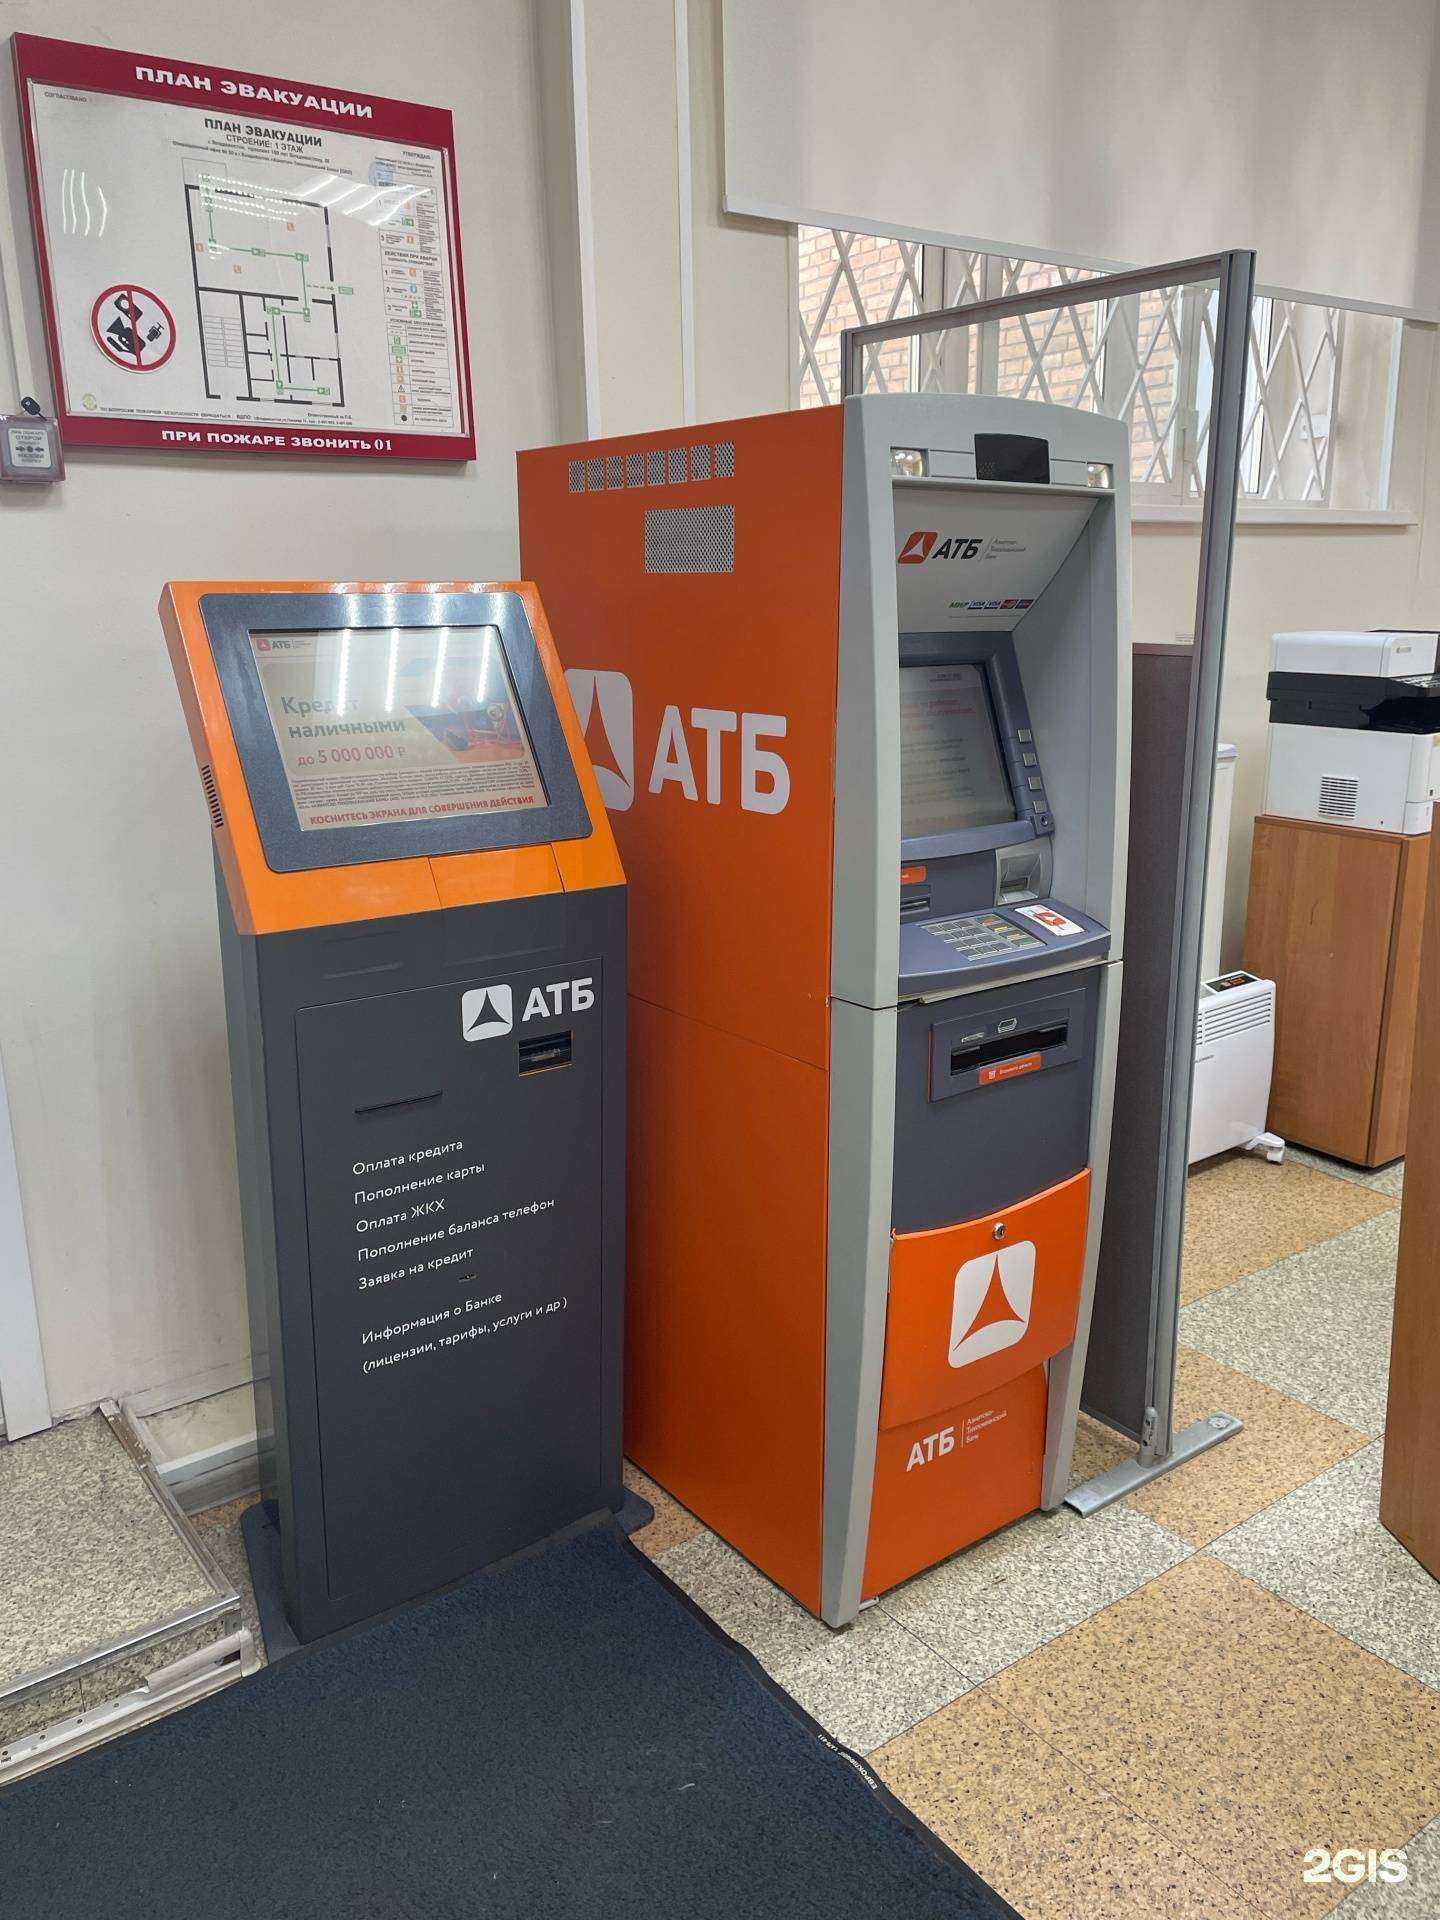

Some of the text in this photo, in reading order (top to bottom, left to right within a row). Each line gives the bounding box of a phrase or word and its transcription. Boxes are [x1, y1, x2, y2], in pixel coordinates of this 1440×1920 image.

[135, 66, 373, 119] ПЛАН ЭВАКУАЦИИ
[204, 118, 241, 134] ПЛАН
[245, 125, 322, 147] ЭВАКУАЦИИ
[275, 140, 279, 149] 1
[281, 144, 303, 154] ЭТАЖ
[161, 430, 392, 451] ПРИ ПОЖАРЕ ЗВОНИТЬ 01
[931, 538, 983, 560] АТБ
[287, 720, 406, 739] наличными
[297, 756, 315, 767] до
[318, 749, 328, 763] 5
[331, 747, 361, 762] 000
[364, 745, 394, 760] 000
[648, 704, 791, 815] АТБ
[310, 795, 534, 825] КОСНИТЕСЬ ЭКРАНА ДЛЯ СОВЕРШЕНИЯ ДЕЙСТВИЯ
[521, 977, 595, 1022] АТБ
[352, 1140, 463, 1175] Оплата кредита
[354, 1163, 485, 1204] Пополнение карты
[356, 1198, 445, 1233] Оплата ЖКХ
[358, 1199, 555, 1262] Пополнение баланса телефон
[358, 1248, 474, 1290] Заявка на кредит
[362, 1293, 502, 1344] Информация о Банке
[362, 1341, 437, 1374] (лицензии,
[438, 1325, 491, 1347] тарифы,
[492, 1310, 532, 1332] услуги
[535, 1305, 543, 1315] и
[906, 1426, 955, 1472] АТБ
